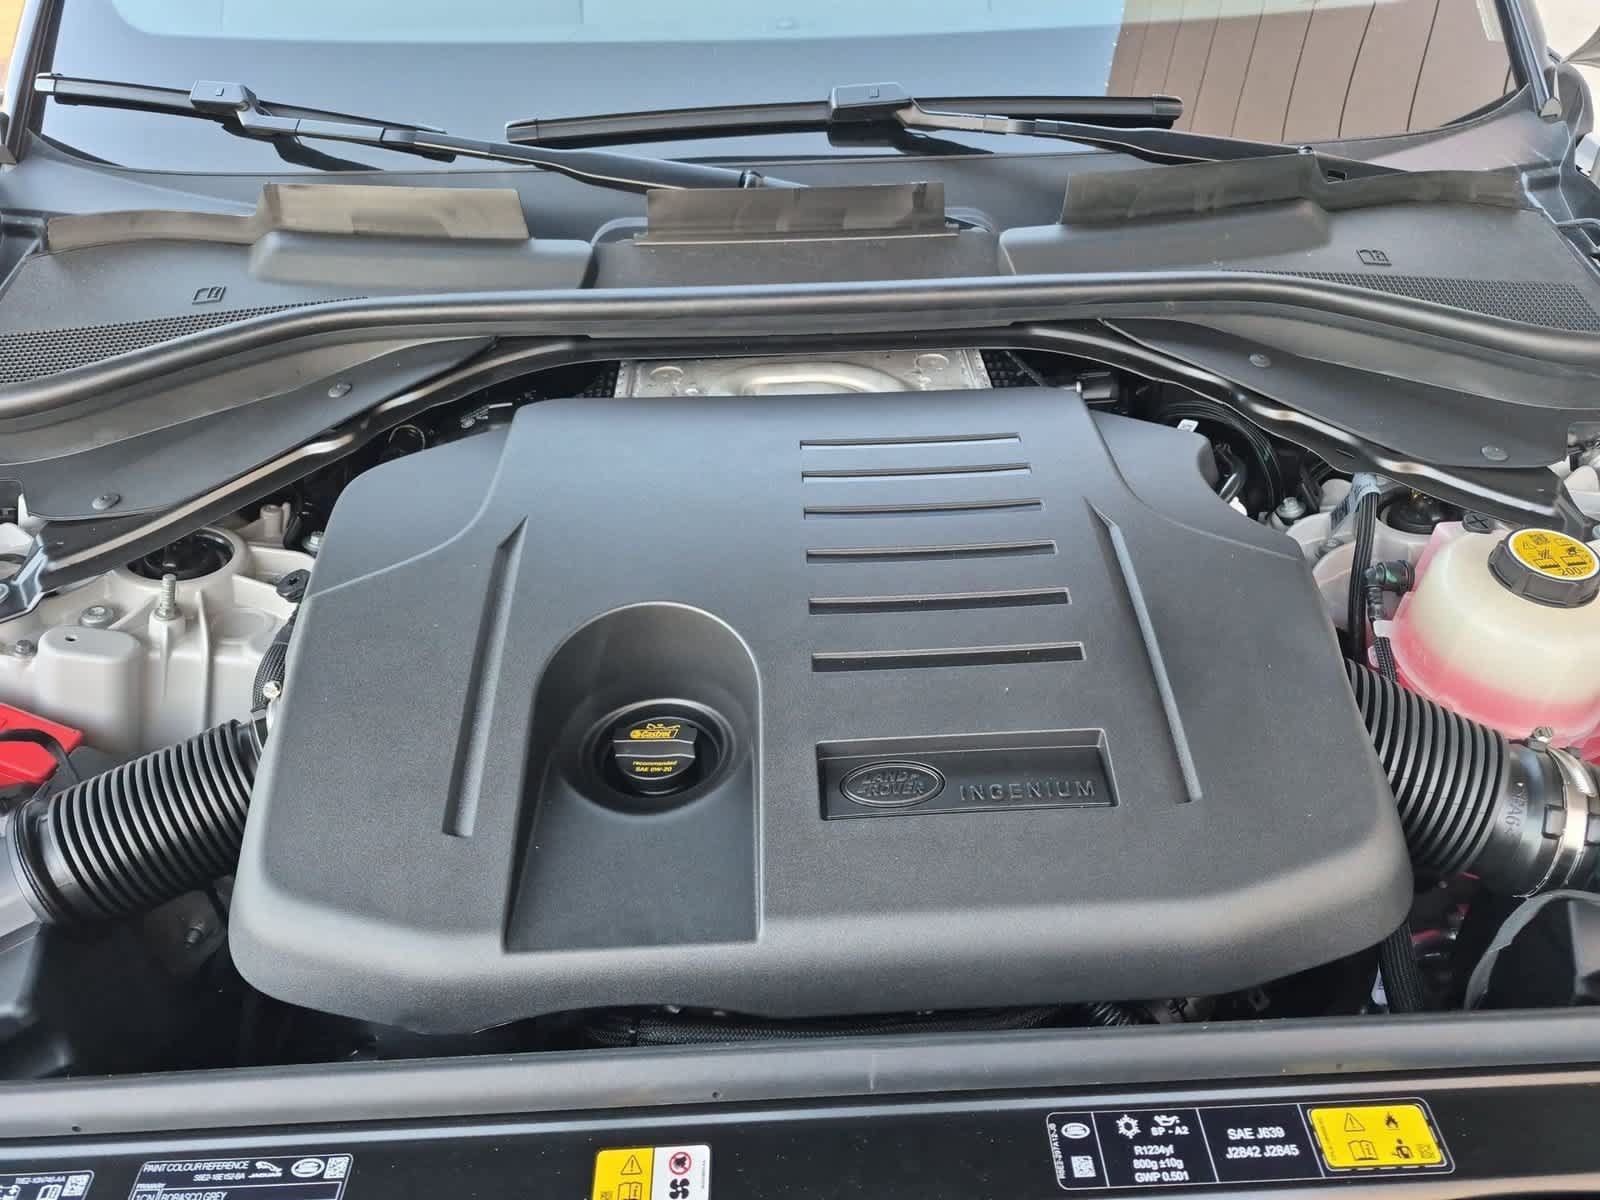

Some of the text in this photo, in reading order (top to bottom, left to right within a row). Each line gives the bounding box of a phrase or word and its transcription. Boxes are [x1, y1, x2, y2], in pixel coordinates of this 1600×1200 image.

[641, 729, 672, 738] Castrol
[633, 760, 678, 768] recommended
[862, 770, 909, 785] LAND
[866, 779, 924, 797] ROVER
[959, 779, 1096, 801] INGENIUM
[1175, 1125, 1190, 1135] A2
[1227, 1126, 1286, 1140] SAE J639
[1133, 1144, 1175, 1157] R1234yf
[1225, 1144, 1300, 1159] J2842 J2845
[143, 1160, 250, 1173] PAINT COLOUR REFERENCE
[1134, 1170, 1190, 1183] GWP 0.501
